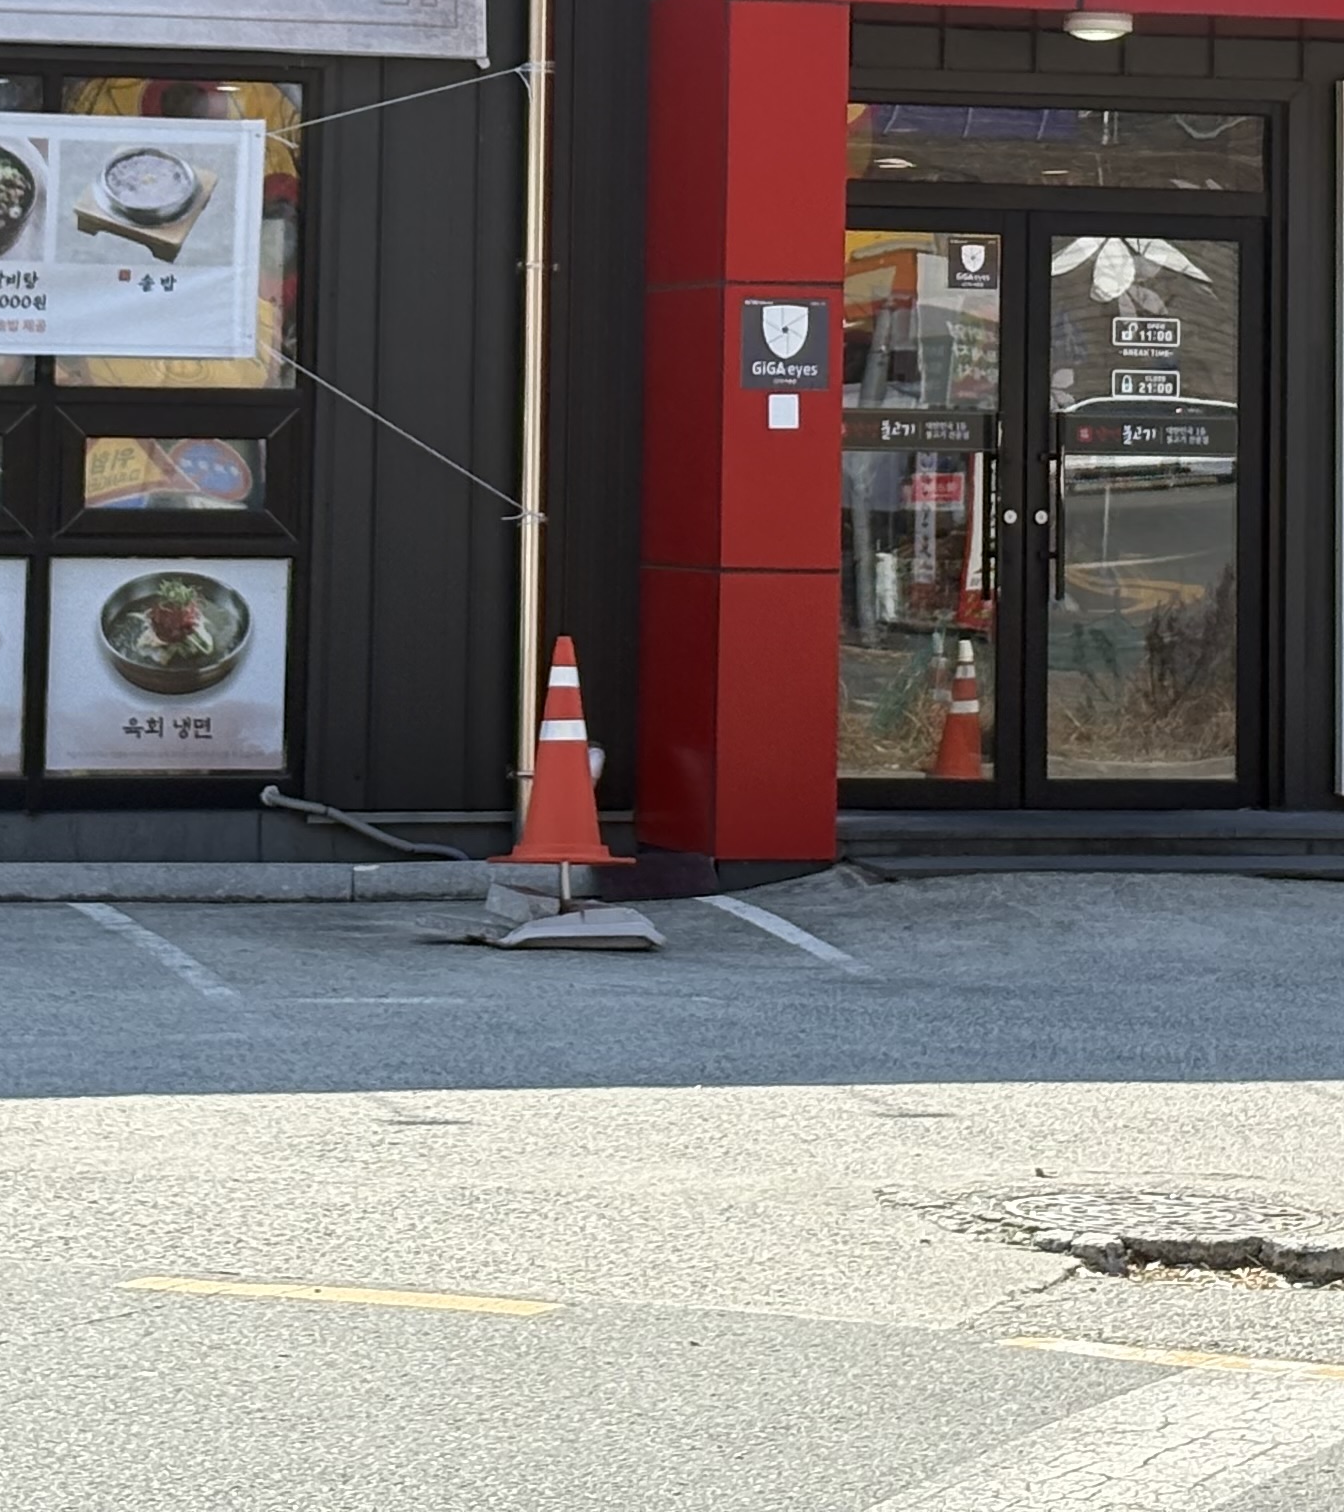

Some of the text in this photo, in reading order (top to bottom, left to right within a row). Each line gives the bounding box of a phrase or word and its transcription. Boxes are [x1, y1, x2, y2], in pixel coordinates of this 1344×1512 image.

[1139, 330, 1173, 342] 11:00
[787, 364, 819, 379] eyes
[1138, 382, 1173, 394] 21:00
[122, 716, 213, 740] 육회 냉면
